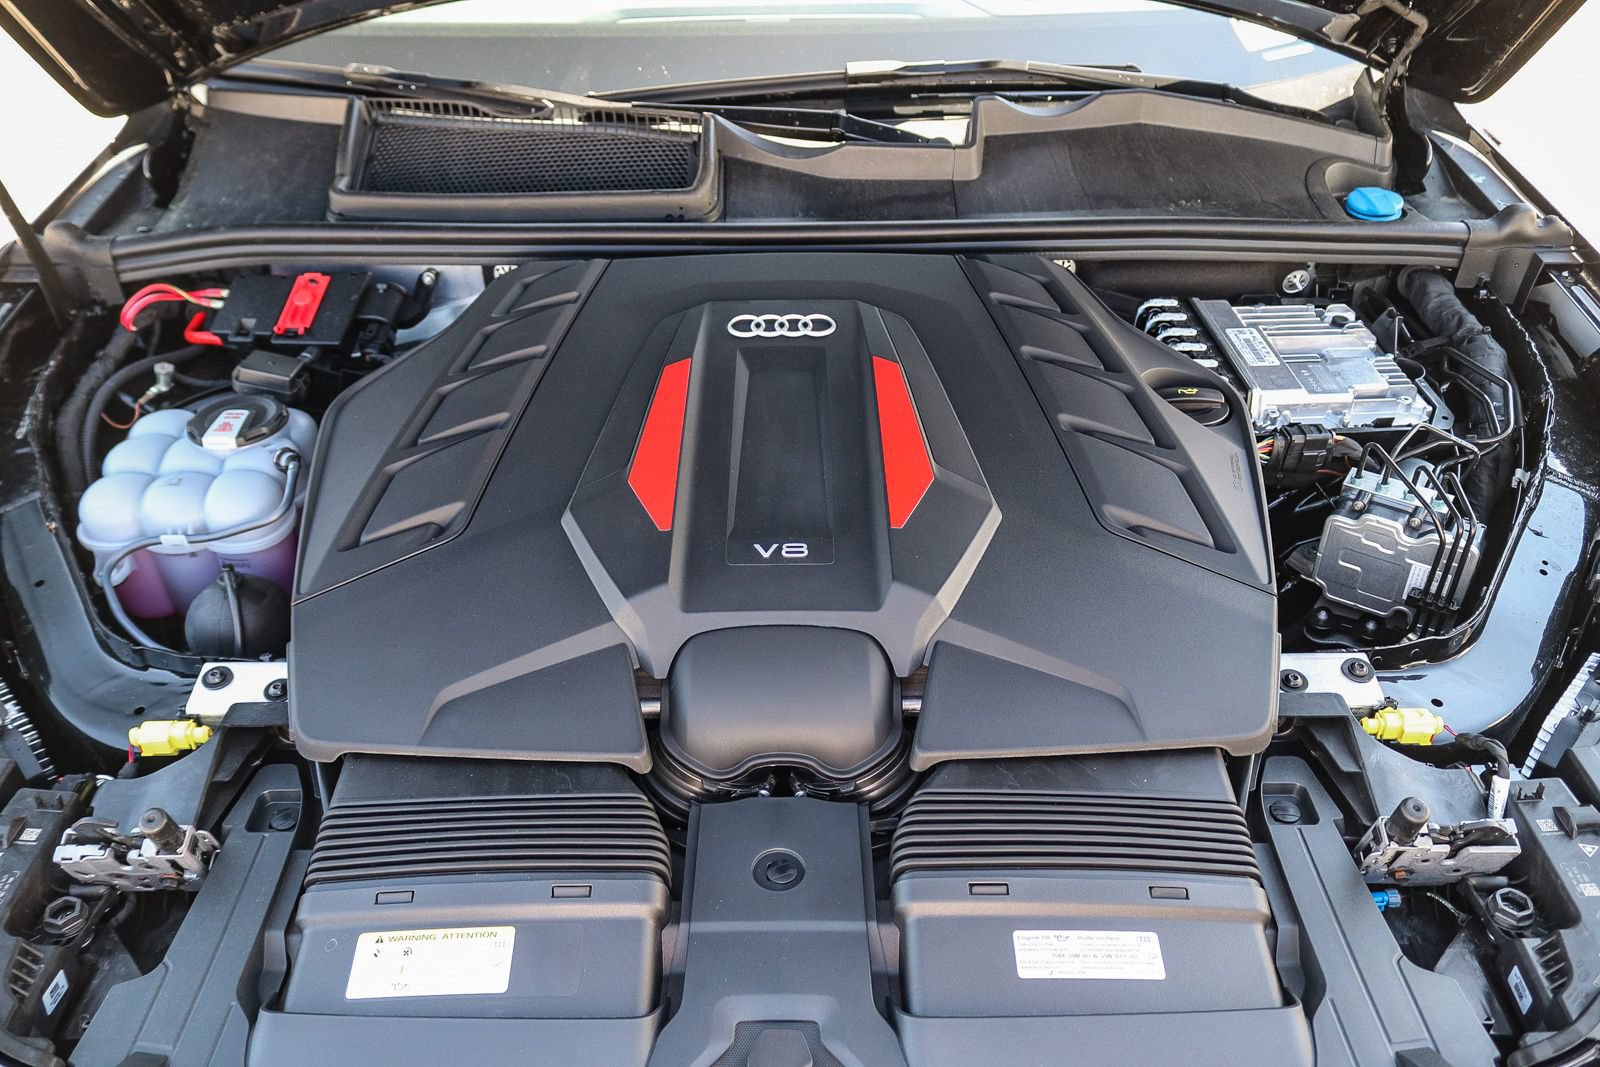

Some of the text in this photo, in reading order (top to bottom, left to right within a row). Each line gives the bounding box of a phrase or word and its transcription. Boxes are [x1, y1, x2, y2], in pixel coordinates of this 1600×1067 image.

[753, 543, 808, 558] V8
[388, 931, 498, 943] WARNING ATTENTION
